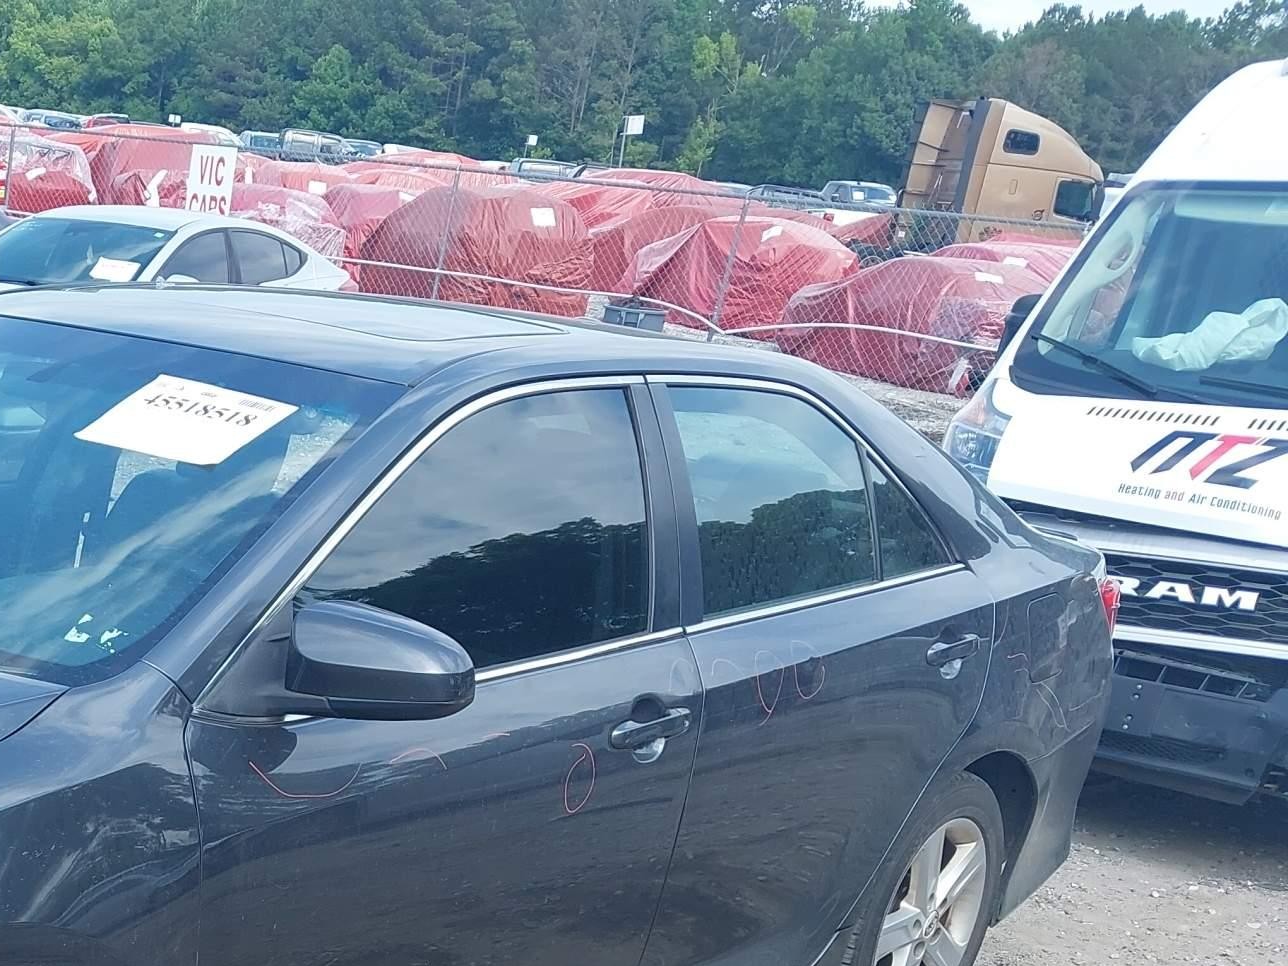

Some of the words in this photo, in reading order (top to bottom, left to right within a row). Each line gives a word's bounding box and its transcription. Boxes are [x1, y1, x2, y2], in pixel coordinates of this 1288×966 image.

[200, 155, 226, 186] VIC
[143, 394, 258, 426] 45518518
[1117, 482, 1162, 499] Heating
[1164, 489, 1185, 502] and
[1188, 493, 1207, 505] Air
[1209, 496, 1283, 521] Conditioning
[1106, 575, 1260, 611] RAM
